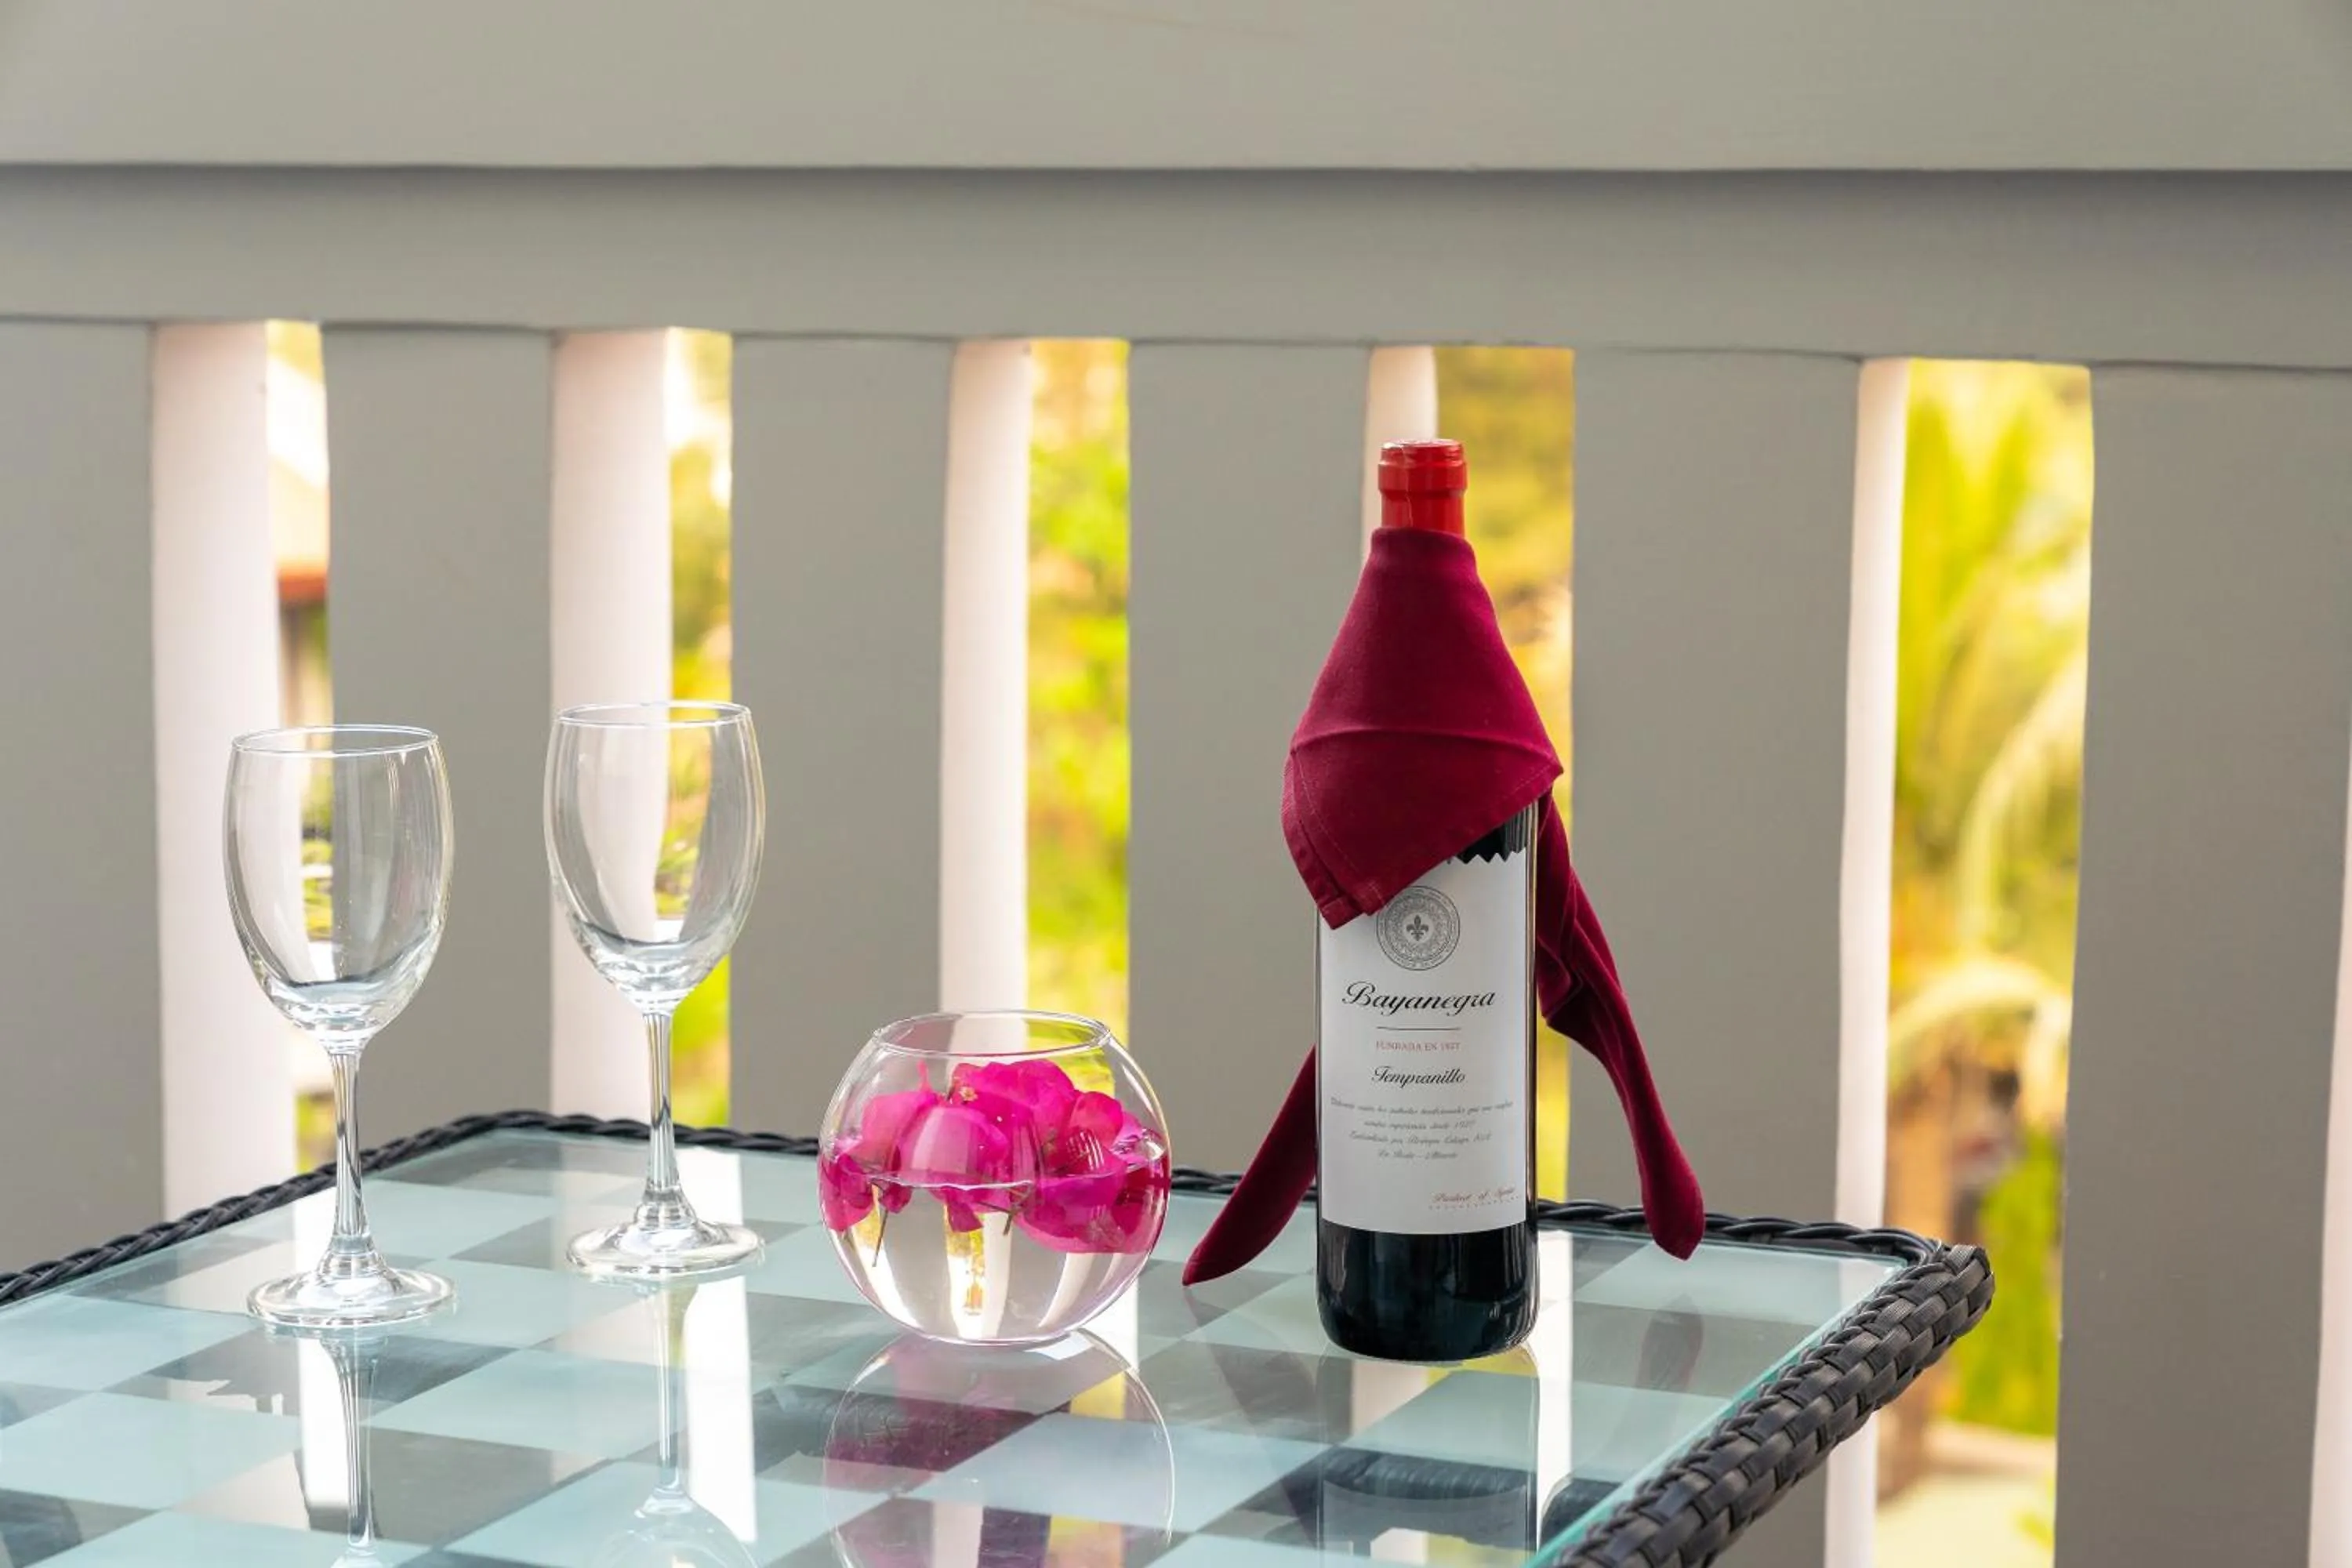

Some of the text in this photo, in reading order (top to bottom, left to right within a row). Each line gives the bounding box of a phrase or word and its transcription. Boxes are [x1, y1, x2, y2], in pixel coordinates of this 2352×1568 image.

[1341, 981, 1496, 1017] Bayanegra
[1425, 1041, 1438, 1051] EN
[1371, 1065, 1466, 1089] Tempranillo
